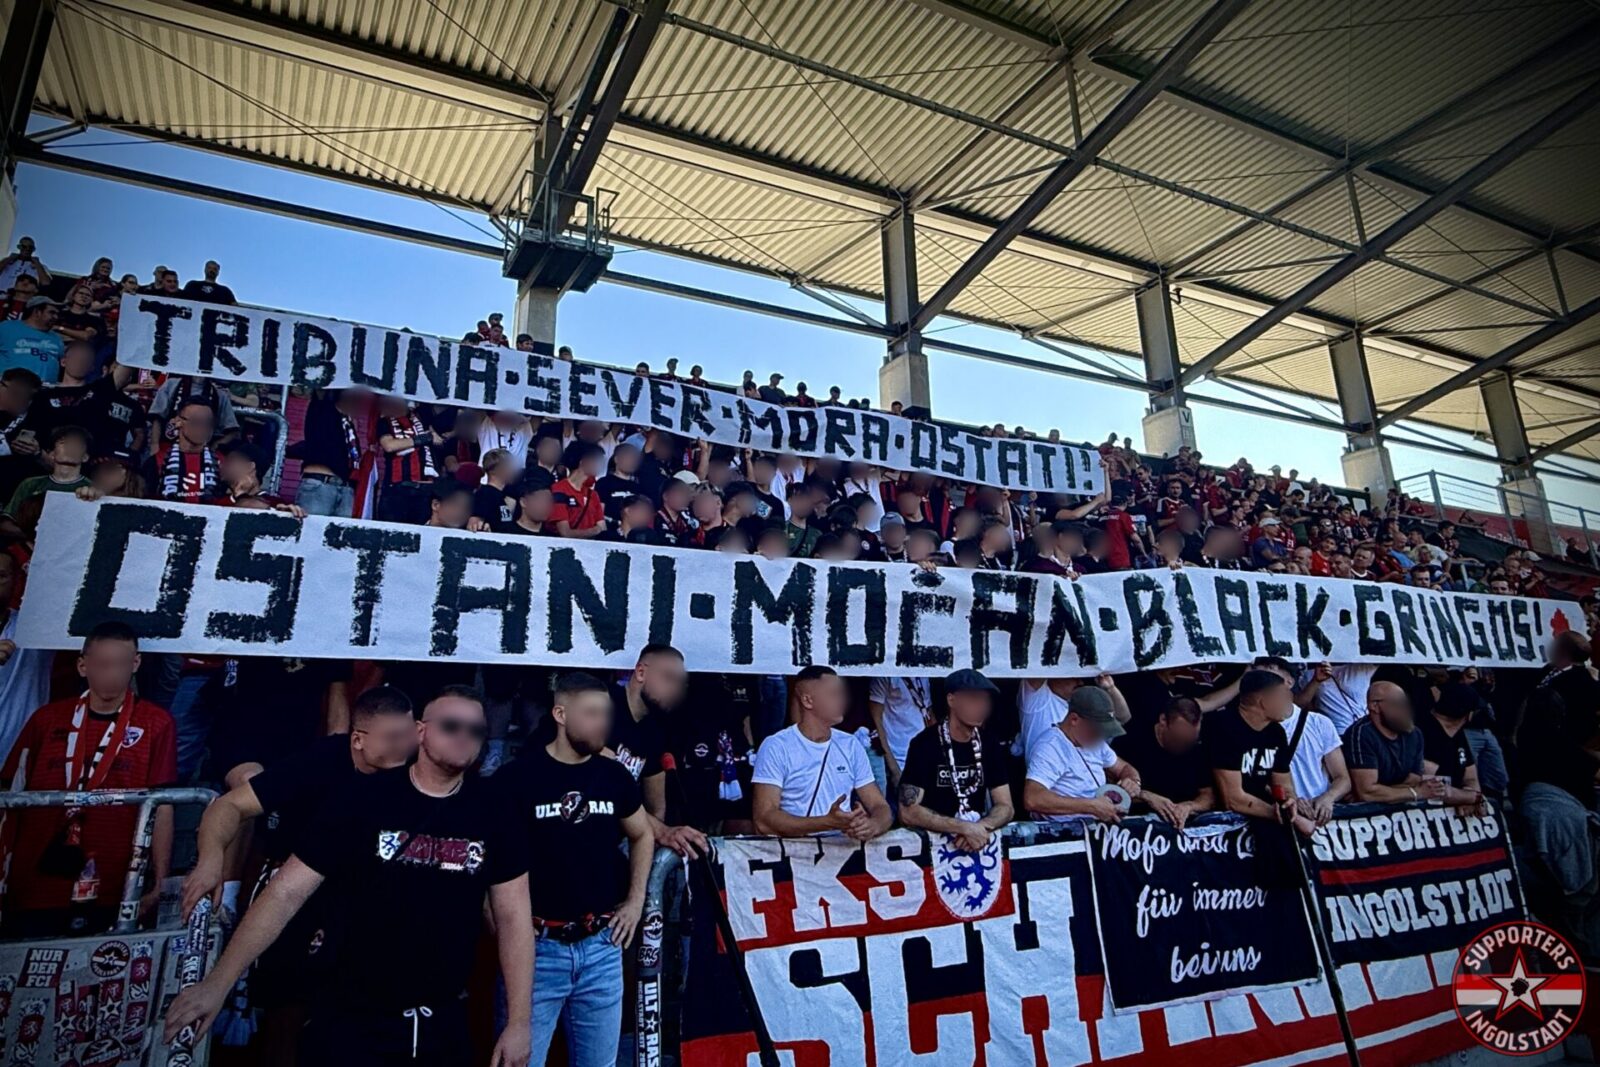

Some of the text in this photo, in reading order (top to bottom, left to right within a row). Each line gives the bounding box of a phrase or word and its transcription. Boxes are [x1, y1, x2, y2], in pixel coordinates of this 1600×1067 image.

[138, 298, 499, 405] TRIBUNA
[524, 354, 716, 436] SEVER
[736, 399, 890, 461] MORA
[69, 503, 676, 655] OSTANI
[1123, 572, 1332, 671] BLACK
[1310, 795, 1500, 862] SUPPORTERS
[718, 827, 927, 941] FKS
[1193, 881, 1268, 911] immer
[1325, 868, 1515, 943] INGOLSTADT
[25, 975, 53, 987] FCI
[26, 962, 58, 974] DER
[29, 949, 63, 961] NUR
